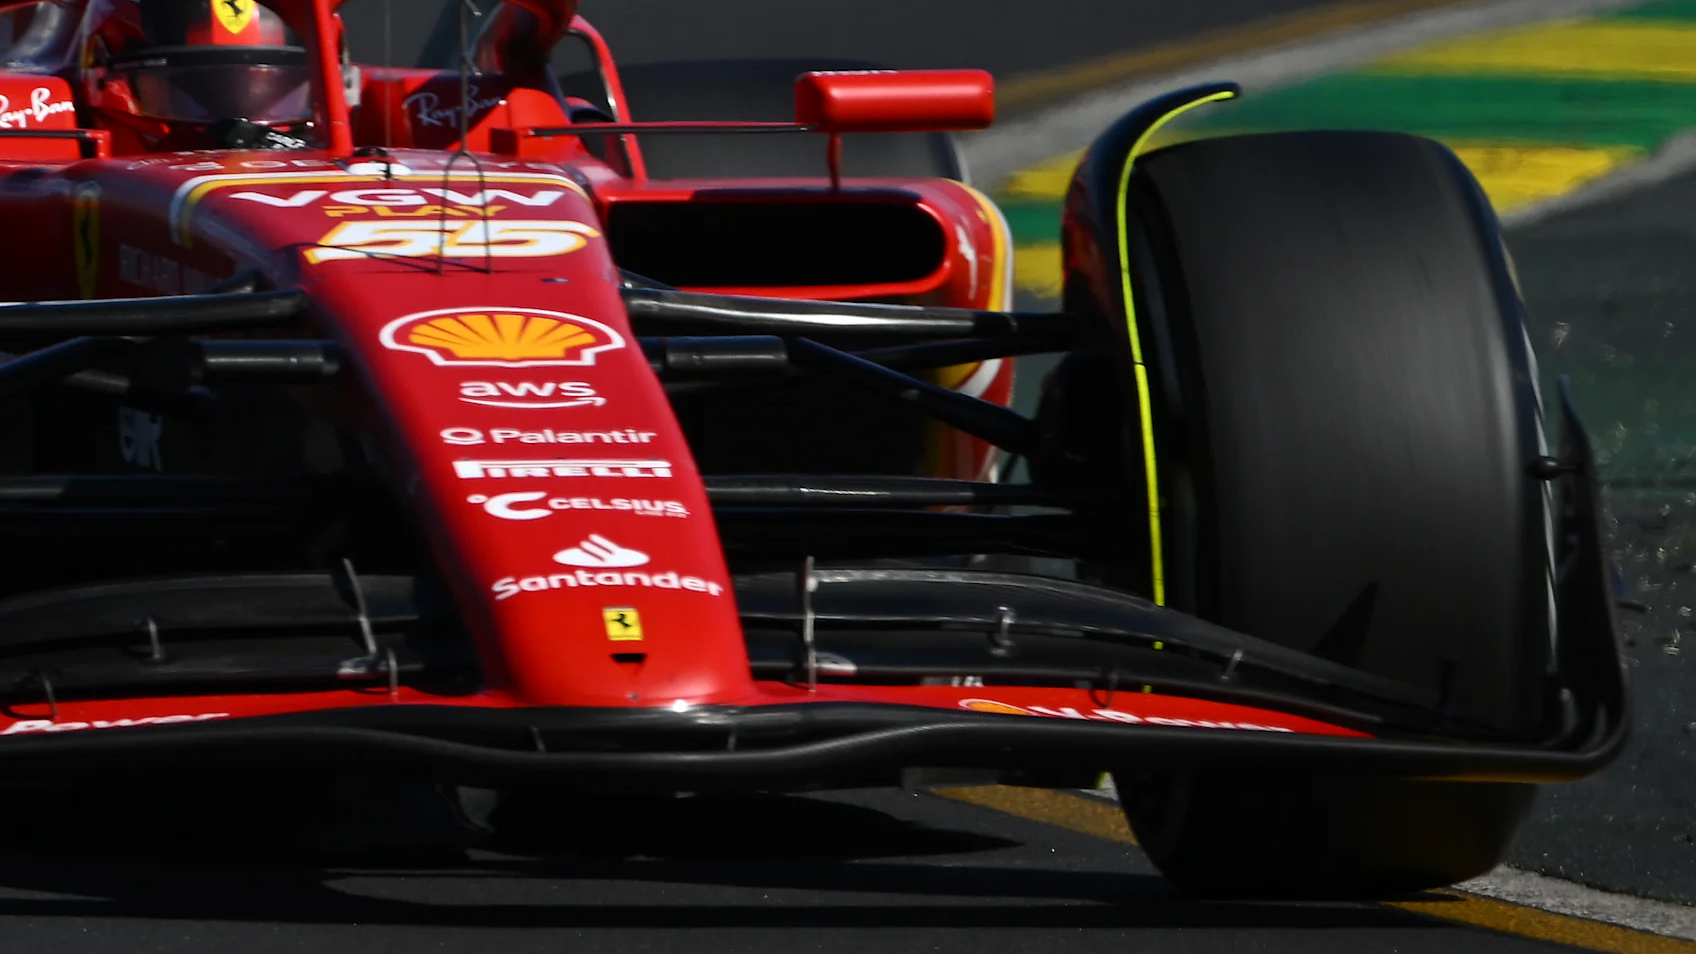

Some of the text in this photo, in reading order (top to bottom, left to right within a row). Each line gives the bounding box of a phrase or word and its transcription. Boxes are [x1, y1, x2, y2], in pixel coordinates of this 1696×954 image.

[229, 187, 567, 208] VGW
[321, 204, 509, 218] PLAY
[302, 219, 601, 266] 55
[459, 381, 598, 398] aws
[490, 428, 657, 445] Palantir
[452, 458, 673, 479] PIRELLI
[548, 496, 687, 515] CELSIUS
[491, 569, 724, 601] Santander
